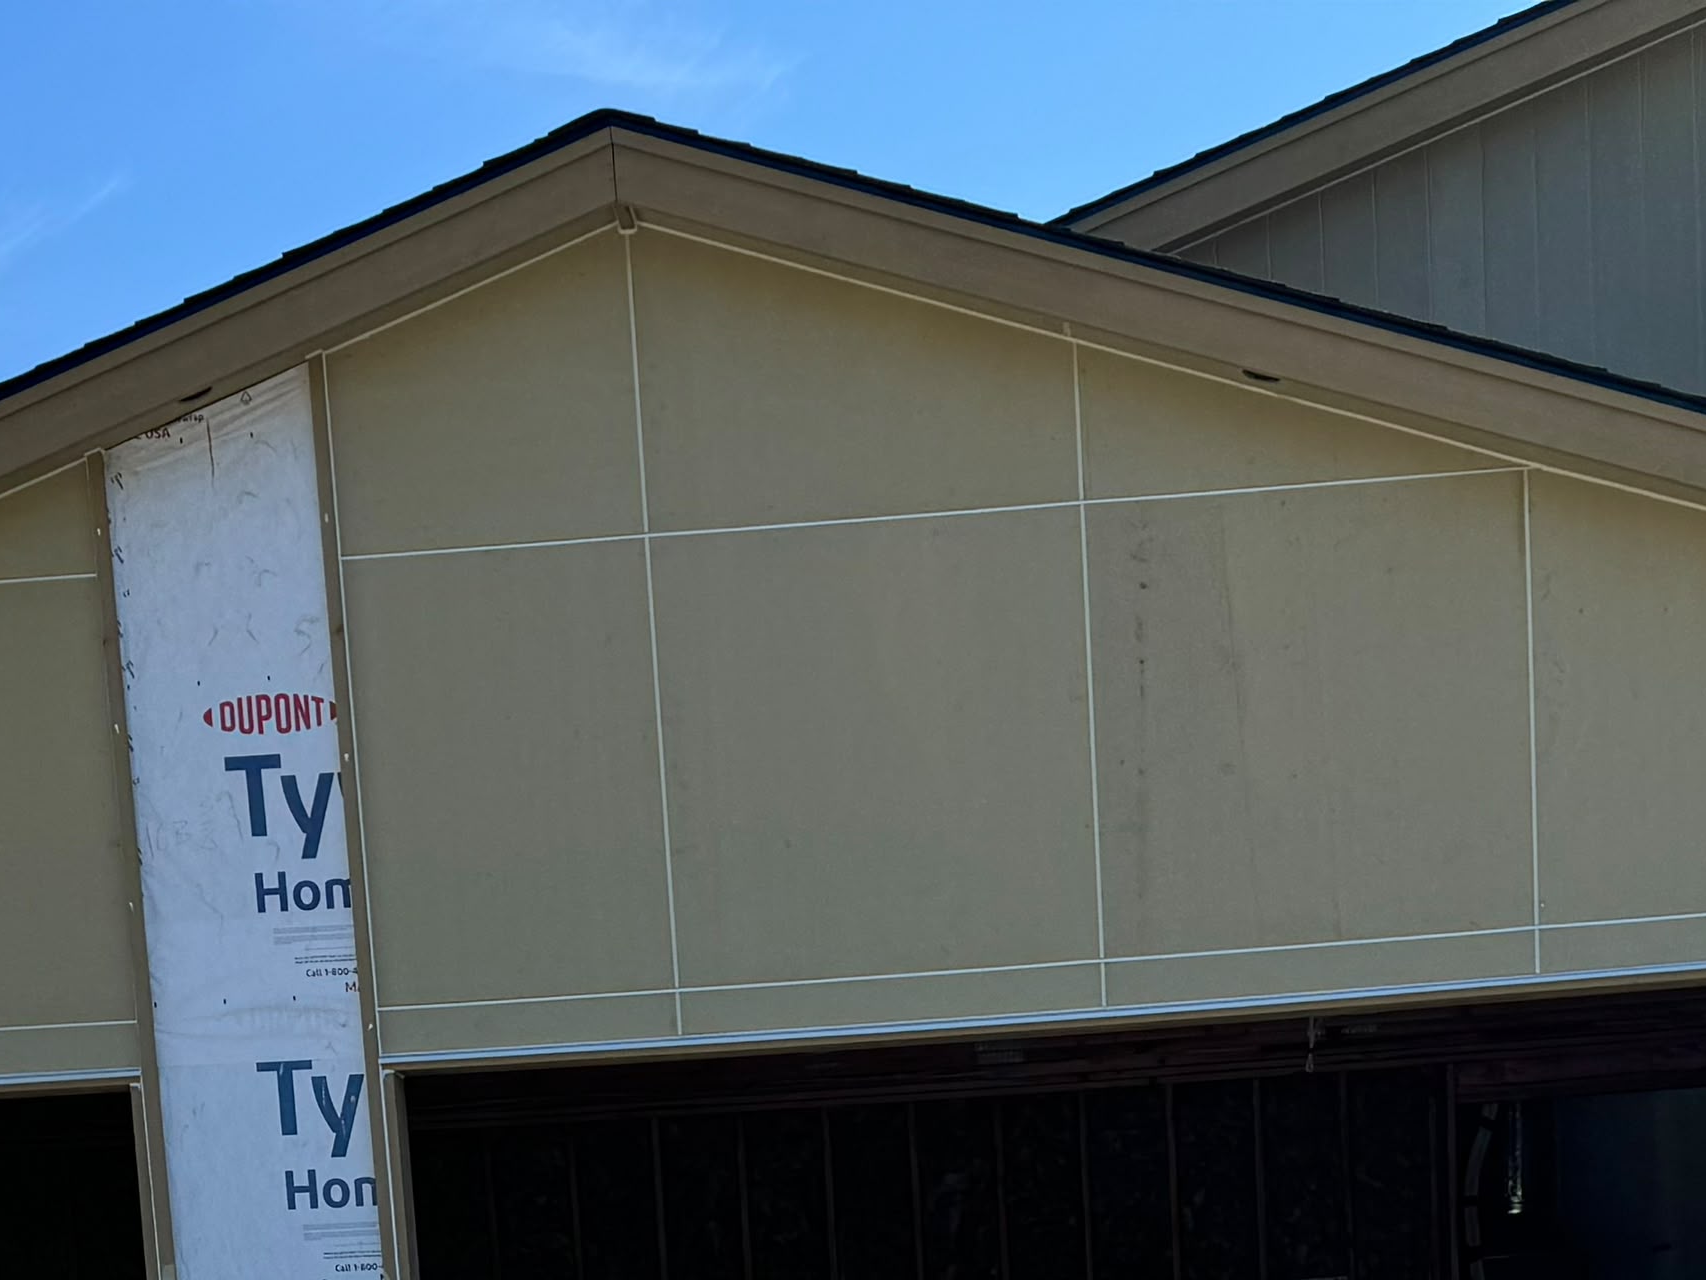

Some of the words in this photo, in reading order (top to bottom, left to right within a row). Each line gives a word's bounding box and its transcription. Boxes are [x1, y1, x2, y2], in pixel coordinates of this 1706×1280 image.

[219, 693, 324, 735] DUPONT
[224, 753, 344, 859] Ty
[305, 968, 323, 977] Call
[256, 1059, 364, 1158] Ty
